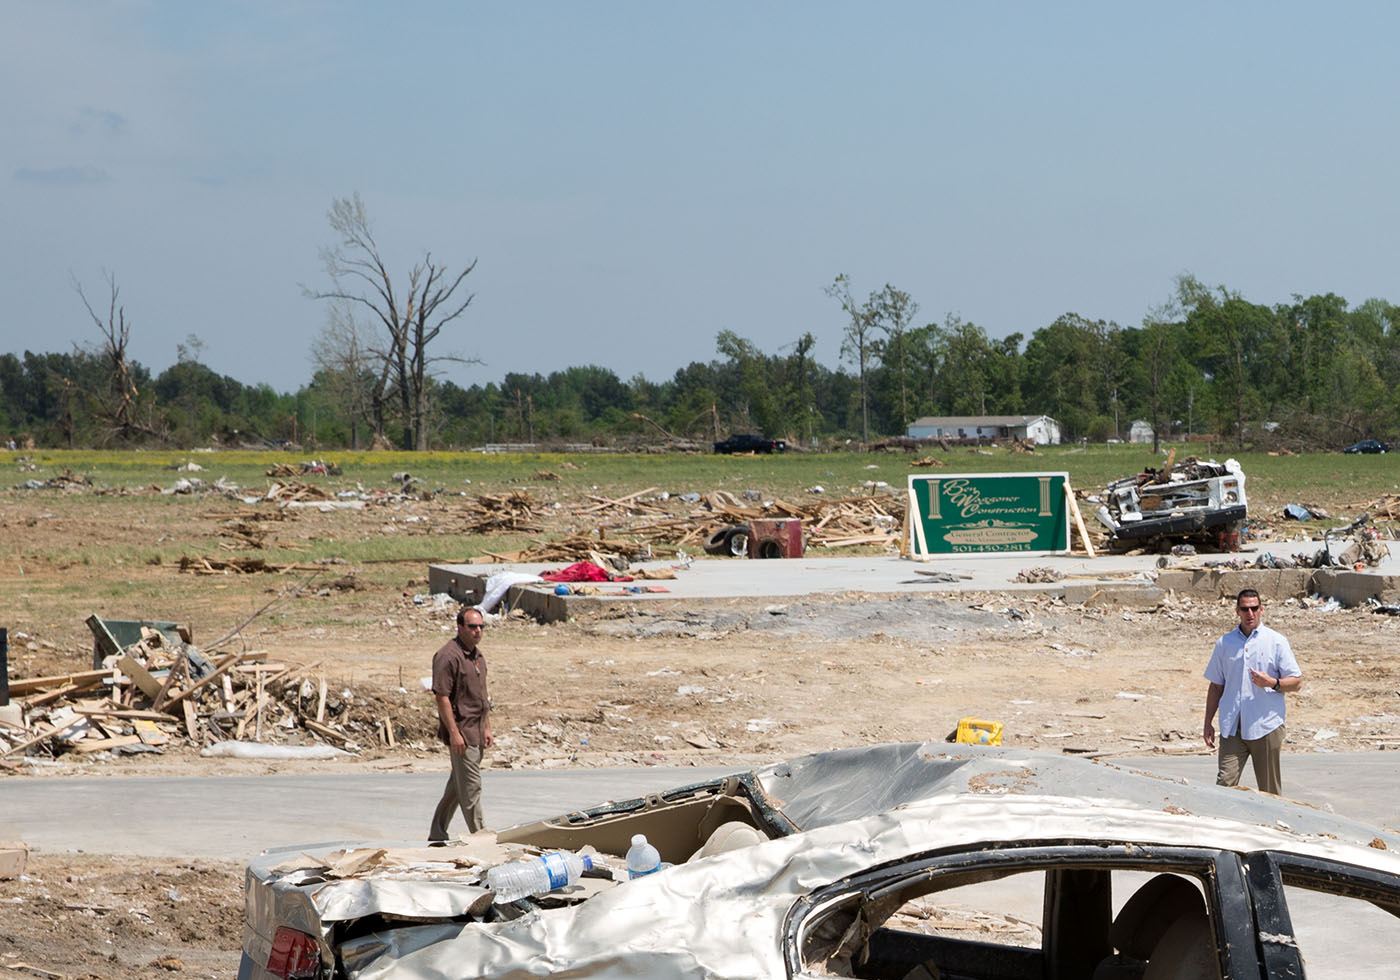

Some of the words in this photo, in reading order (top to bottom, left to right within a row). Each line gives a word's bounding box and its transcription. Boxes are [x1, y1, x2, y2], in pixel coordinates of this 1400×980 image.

[943, 479, 977, 495] Ben
[950, 489, 1020, 507] Waggoner
[961, 503, 1037, 518] Construction
[985, 529, 1030, 537] Contractor
[952, 543, 1031, 553] 501-450-2815
